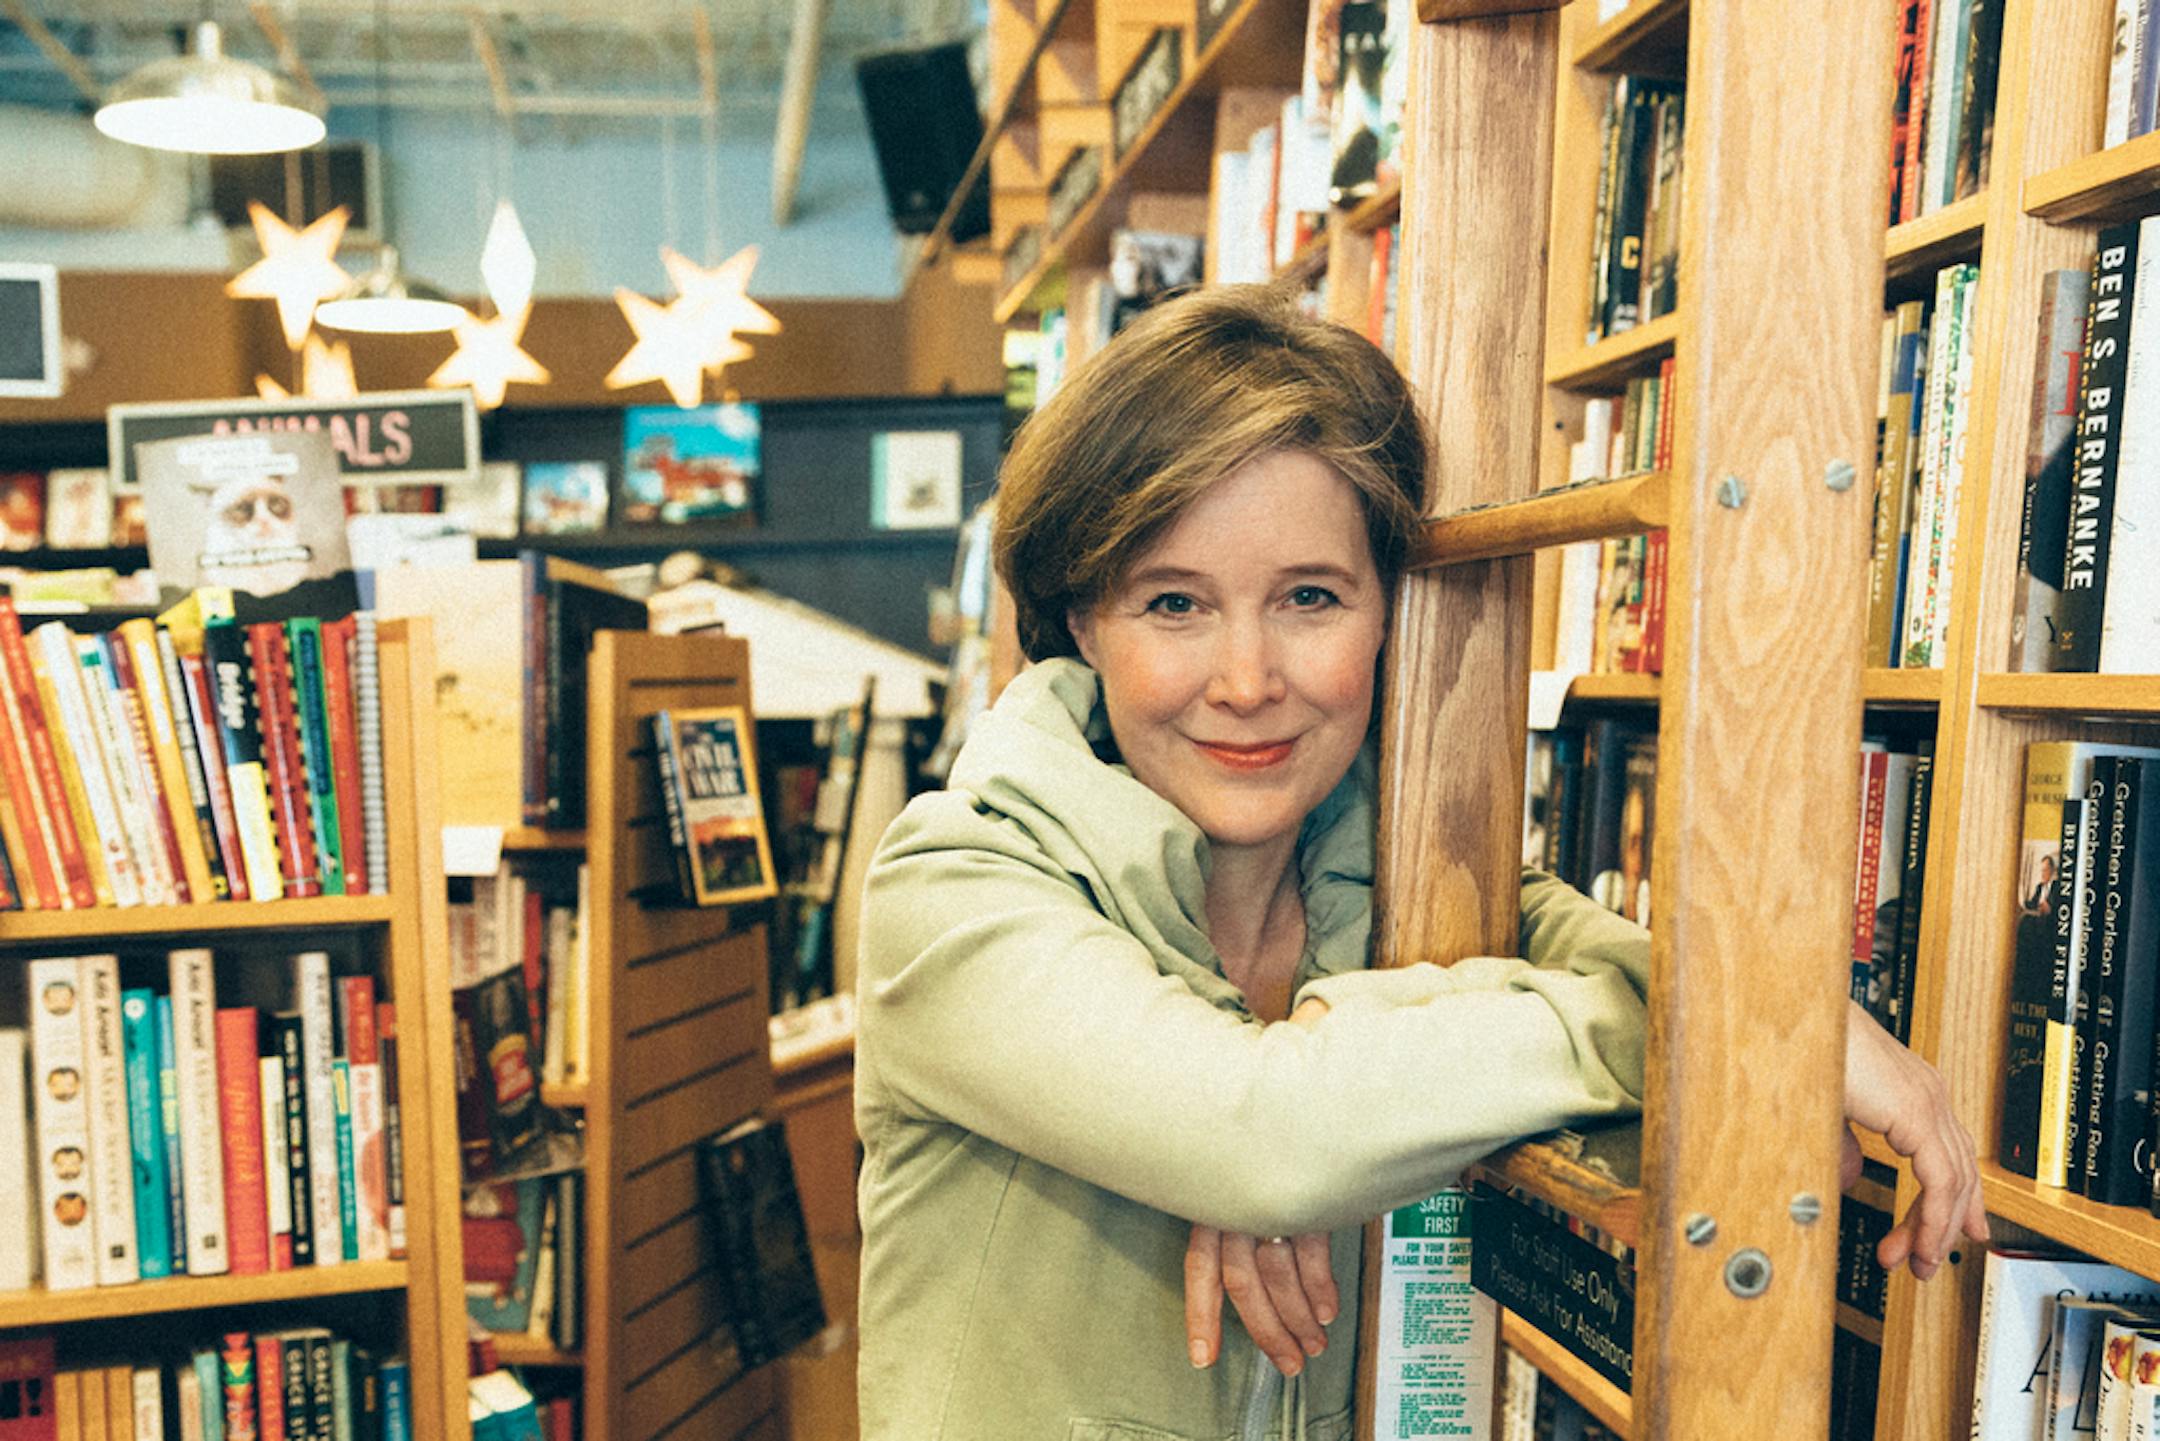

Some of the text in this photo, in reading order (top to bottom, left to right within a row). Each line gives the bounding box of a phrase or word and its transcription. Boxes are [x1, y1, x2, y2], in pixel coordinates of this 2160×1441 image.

[2070, 246, 2126, 590] BEN S. BERNANKE
[215, 661, 247, 729] Bridge
[1907, 756, 1931, 871] Rosemary
[2085, 780, 2104, 884] Gretchen
[1857, 857, 1871, 937] JOHNSON
[2052, 823, 2076, 998] BRAIN ON FIRE
[2078, 888, 2096, 972] Carlson
[2086, 782, 2130, 1176] Gretchen Carlson Getting Real
[1406, 1243, 1420, 1253] FOR
[1424, 1243, 1445, 1253] YOUR
[1420, 1196, 1466, 1213] SAFETY
[1425, 1217, 1459, 1233] FIRST
[1392, 1255, 1420, 1265] PLEASE
[1424, 1255, 1443, 1265] READ
[1512, 1222, 1621, 1324] For Staff Use Only
[1490, 1254, 1633, 1377] Please Ask For Assistanc
